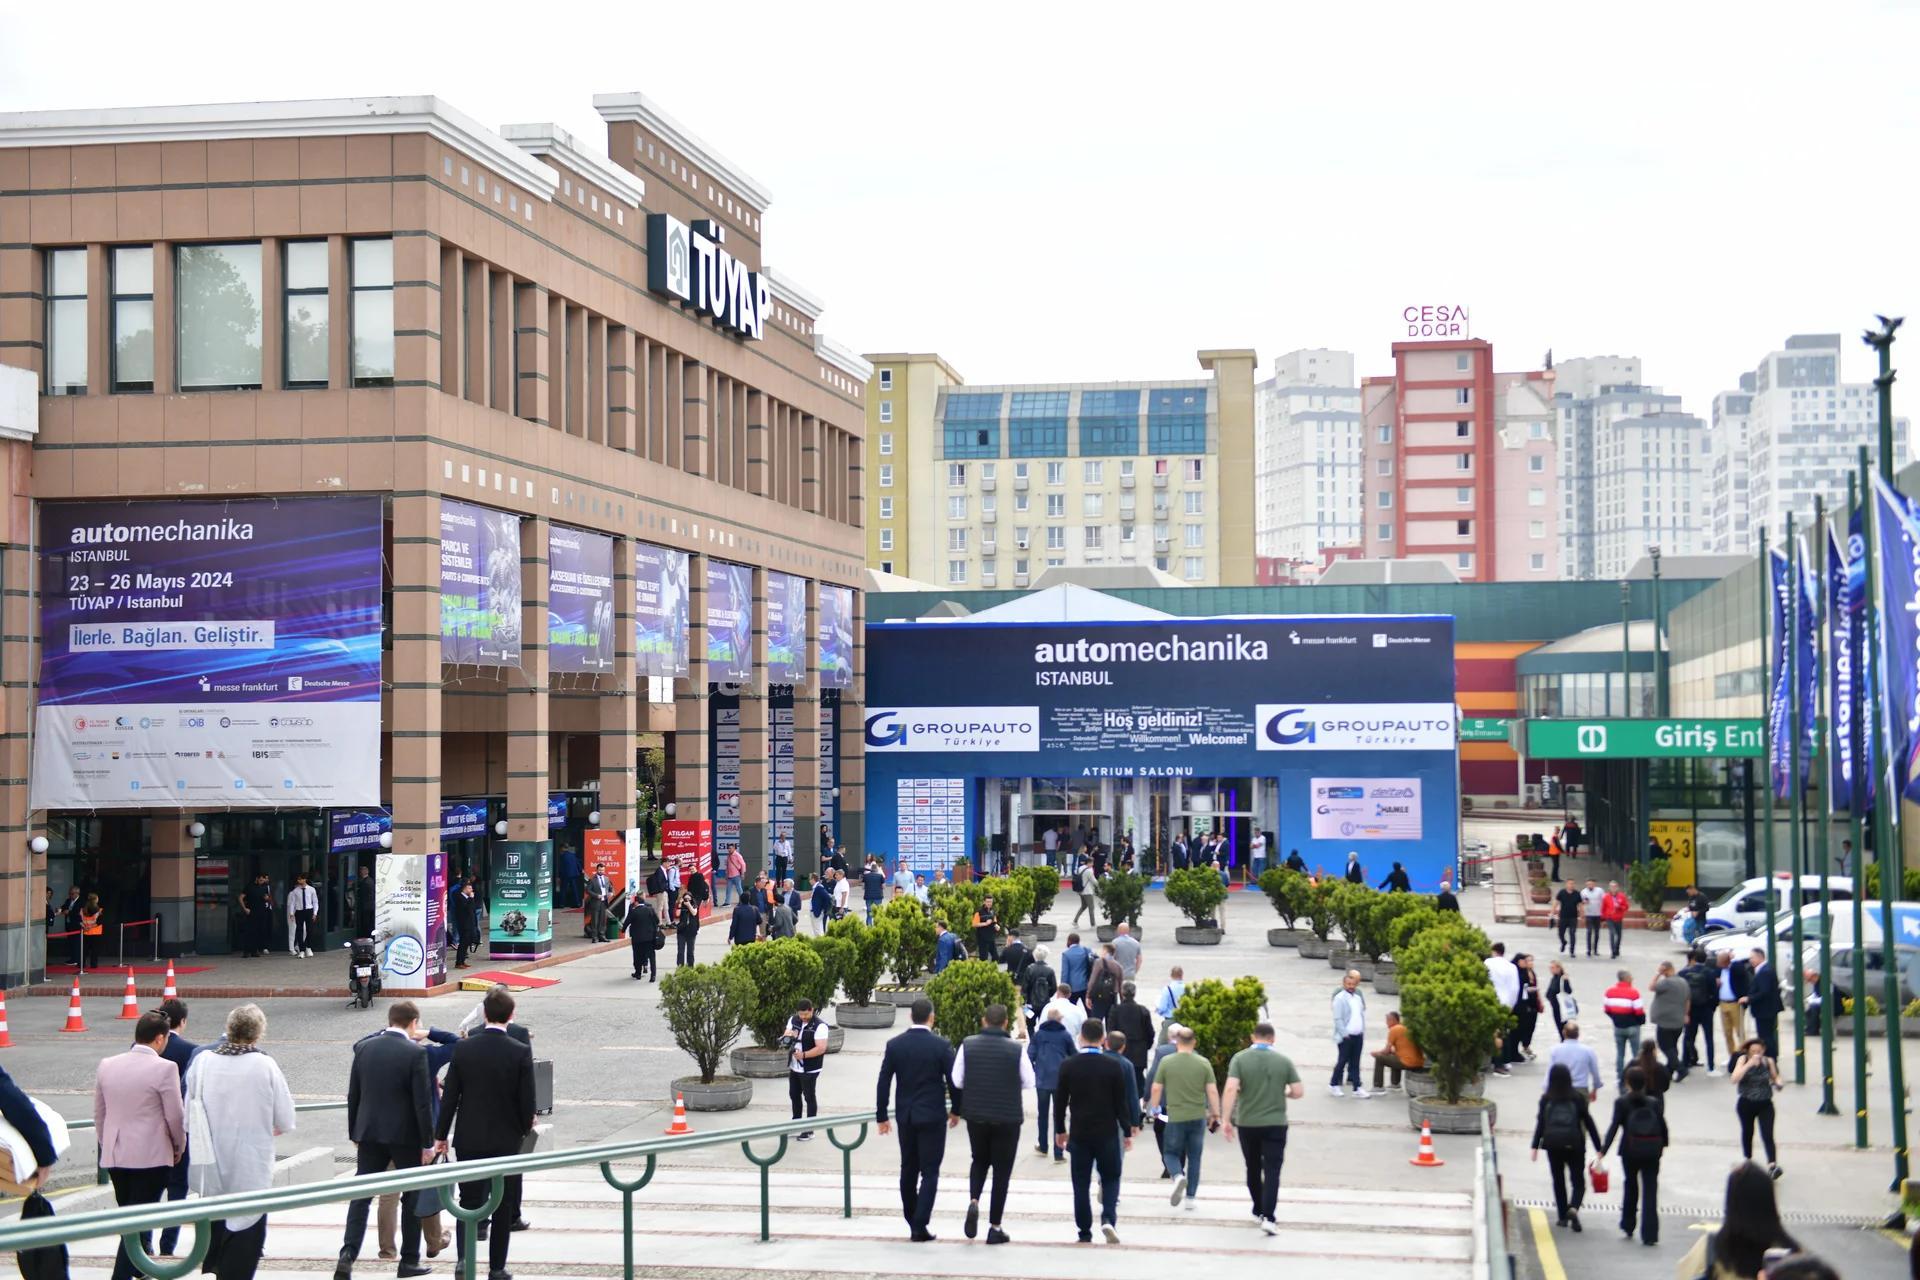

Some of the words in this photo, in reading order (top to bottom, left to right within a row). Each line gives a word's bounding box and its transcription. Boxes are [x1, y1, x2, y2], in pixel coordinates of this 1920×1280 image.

[693, 219, 771, 341] TÜYAP
[1404, 305, 1466, 322] CESA
[71, 518, 254, 544] automechanika
[71, 550, 130, 563] ISTANBUL
[70, 575, 89, 591] 23
[110, 574, 130, 590] 26
[136, 573, 185, 592] Mayıs
[190, 572, 233, 588] 2024
[70, 595, 114, 611] TÜYAP
[117, 596, 124, 609] /
[127, 595, 183, 609] Istanbul
[74, 626, 115, 645] İlerle.
[122, 627, 187, 647] Bağlan.
[194, 626, 263, 646] Geliştir.
[1034, 634, 1268, 663] automechanika
[1036, 671, 1113, 686] ISTANBUL
[242, 683, 278, 691] frankfurt
[1104, 712, 1133, 730] Hoş
[1138, 712, 1203, 730] geldiniz!
[1322, 721, 1449, 732] GROUPAUTO
[912, 723, 1032, 734] GROUPAUTO
[944, 737, 1001, 747] Türkiye
[1130, 734, 1181, 744] Willkommen!
[1189, 733, 1247, 745] Welcome!
[1356, 736, 1416, 744] Türkiye
[1655, 725, 1717, 751] Giriş
[1083, 767, 1133, 776] ATRIUM
[1140, 767, 1194, 776] SALONU
[447, 814, 459, 825] KAYIT
[460, 814, 465, 823] VE
[343, 823, 358, 835] KAYIT
[359, 823, 366, 833] VE
[368, 835, 381, 844] ENTRA
